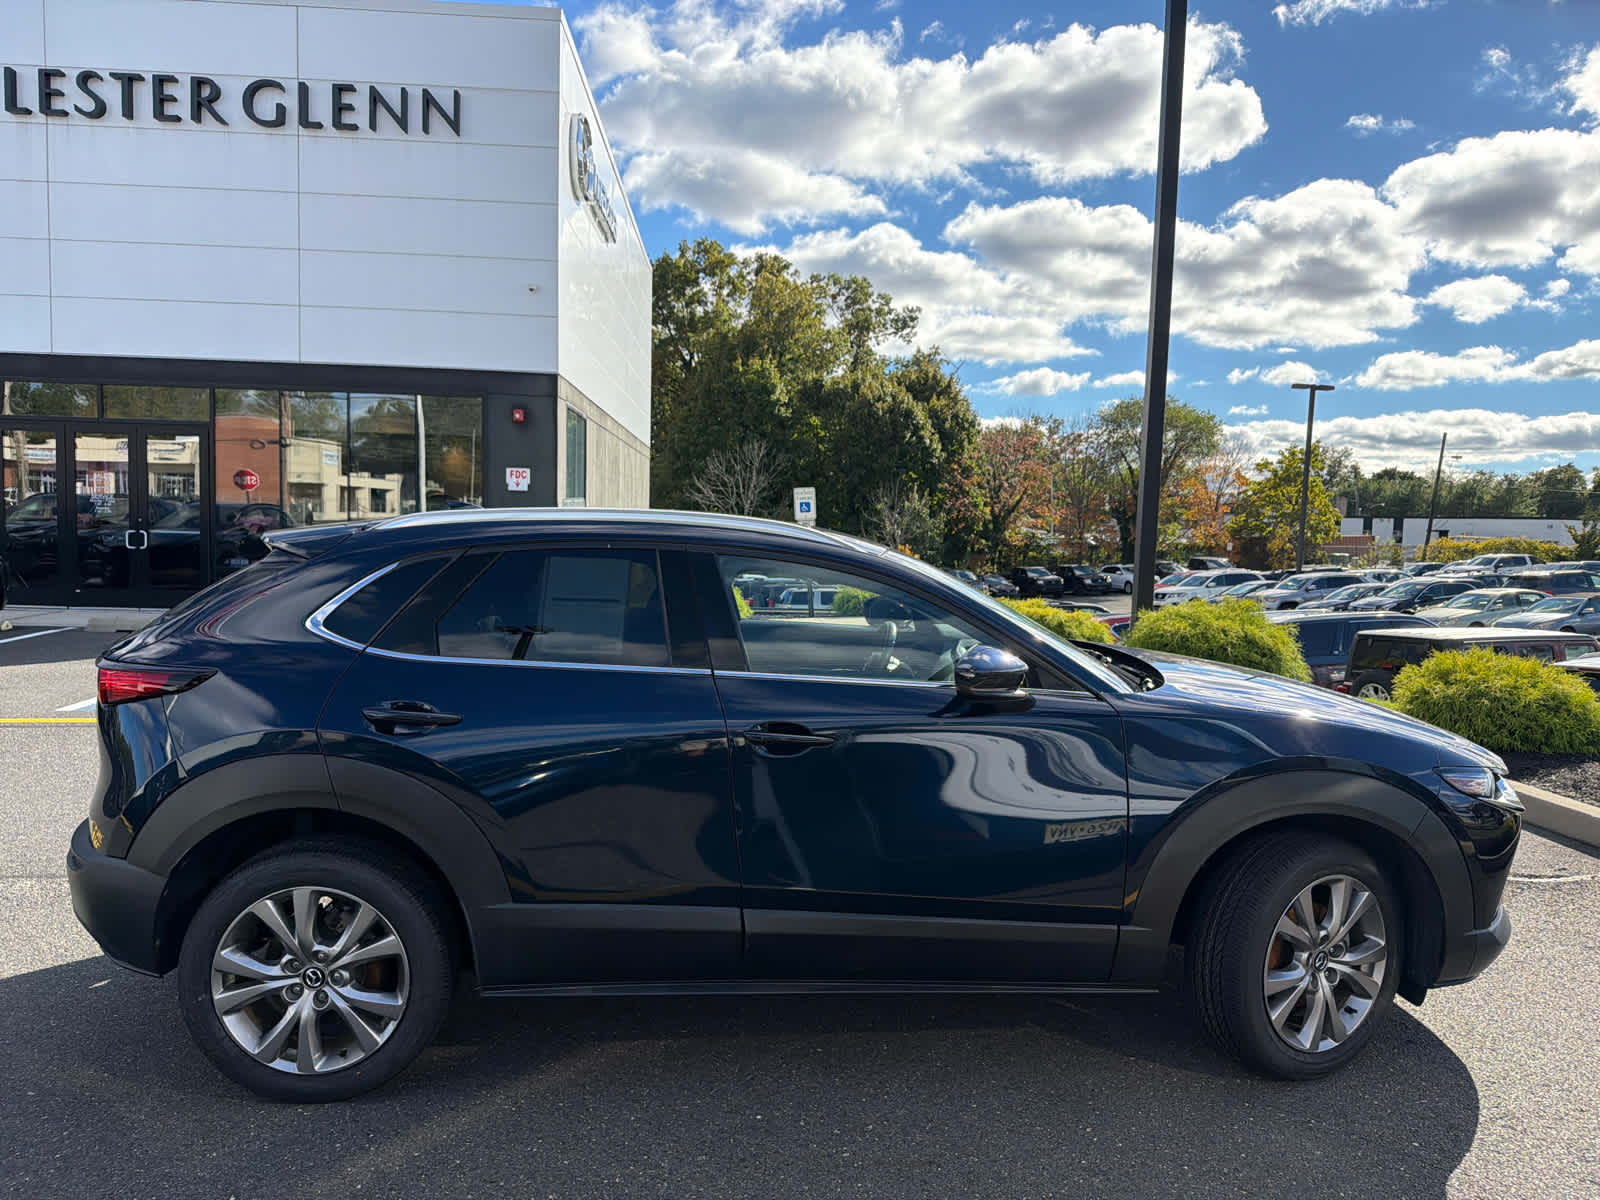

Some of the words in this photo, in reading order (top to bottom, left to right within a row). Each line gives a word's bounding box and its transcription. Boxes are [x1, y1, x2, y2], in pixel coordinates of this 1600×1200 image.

[4, 66, 229, 127] LESTER
[242, 78, 461, 137] GLENN
[510, 470, 528, 480] FDC
